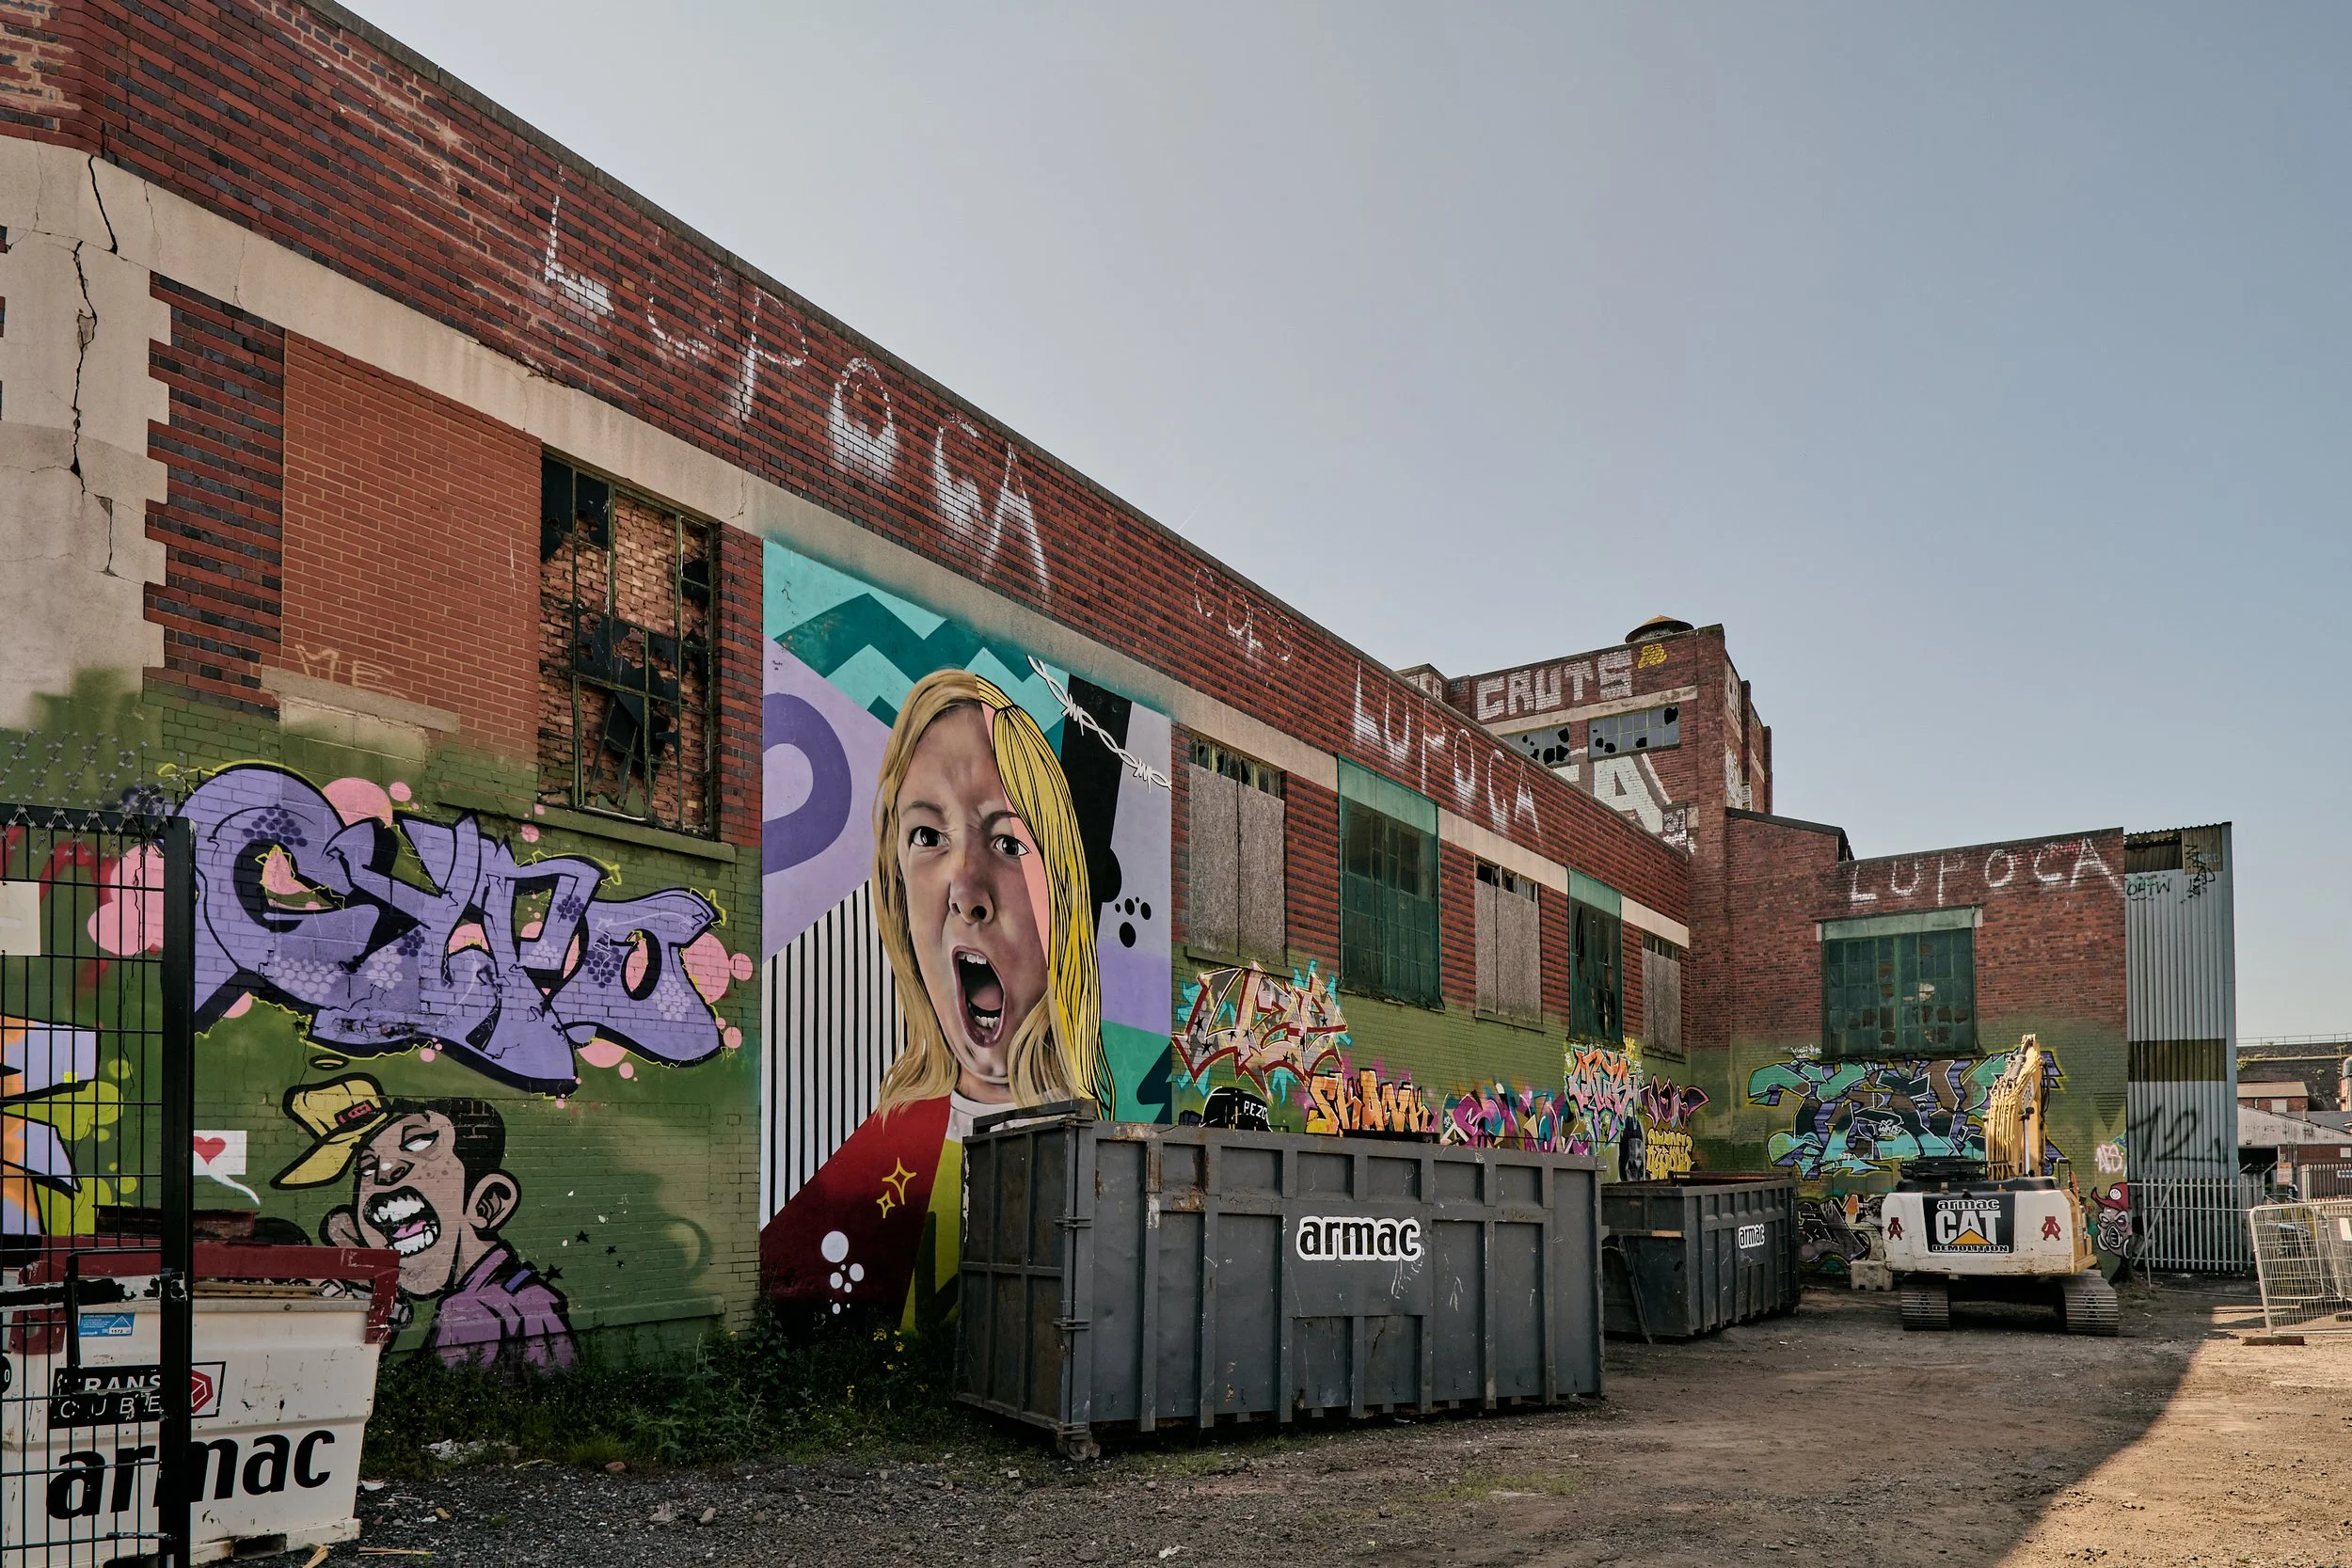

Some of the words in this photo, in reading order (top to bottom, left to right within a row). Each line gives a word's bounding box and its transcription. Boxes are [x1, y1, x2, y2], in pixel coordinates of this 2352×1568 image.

[1851, 838, 2123, 906] LUPOCA
[1936, 1199, 1999, 1211] armac
[1298, 1218, 1420, 1259] armac
[1739, 1225, 1765, 1248] armac
[1935, 1211, 2001, 1245] CAT
[1931, 1244, 2009, 1253] DEMOLITION
[68, 1374, 161, 1393] RANS
